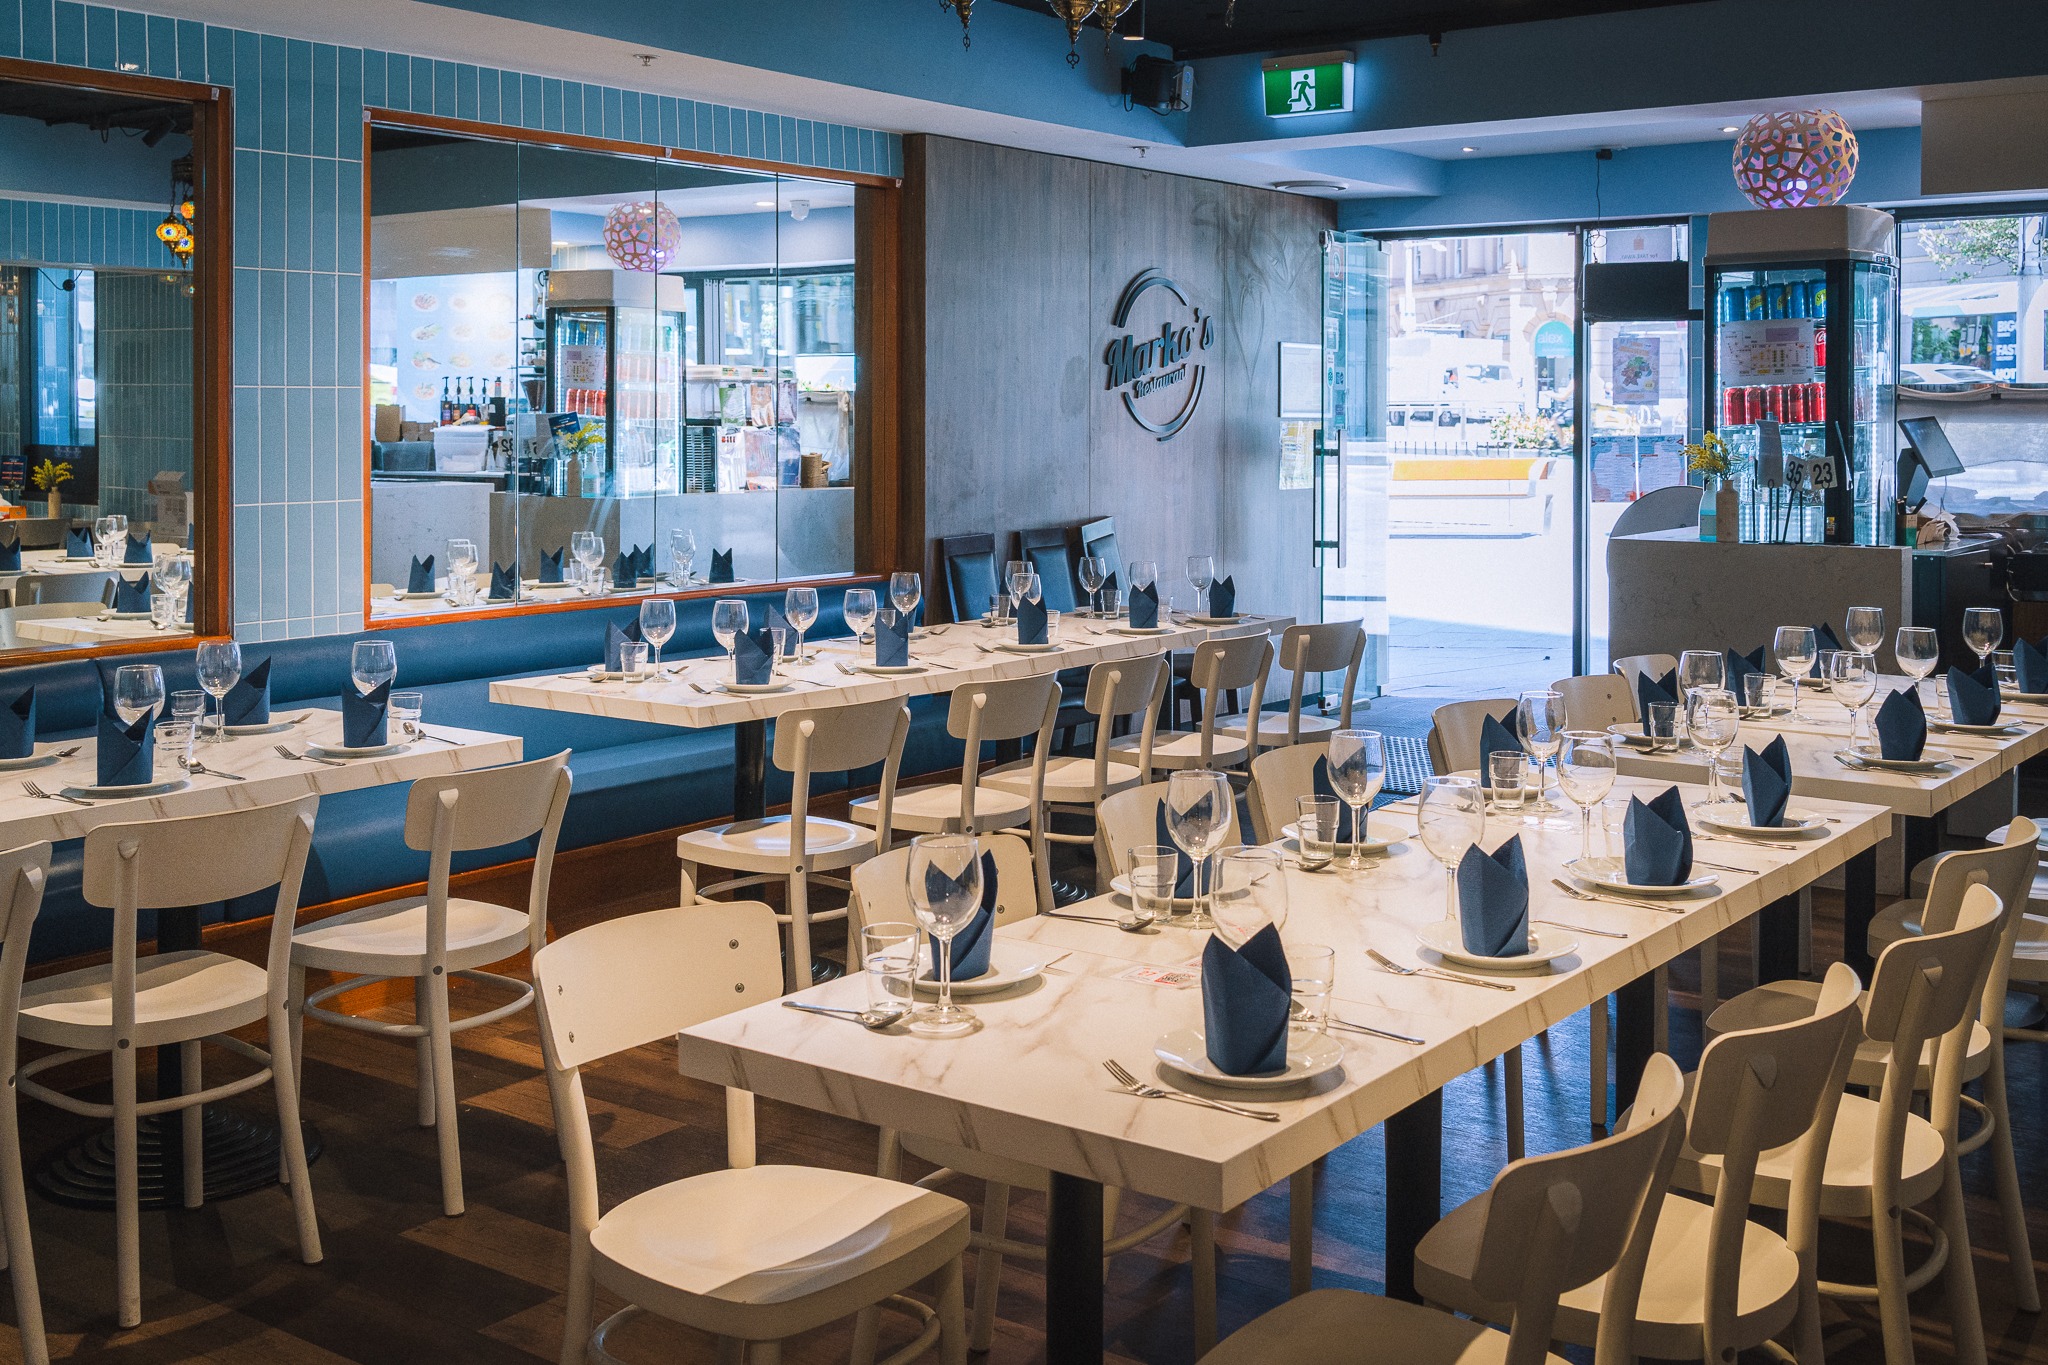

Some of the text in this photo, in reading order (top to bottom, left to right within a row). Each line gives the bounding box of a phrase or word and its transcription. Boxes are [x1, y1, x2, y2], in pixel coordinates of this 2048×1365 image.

[1537, 331, 1564, 344] alex
[1997, 320, 2015, 332] BIG
[1105, 307, 1215, 390] Marko's
[1134, 363, 1187, 398] Restaurant
[1786, 461, 1804, 484] 35
[1813, 462, 1833, 485] 23
